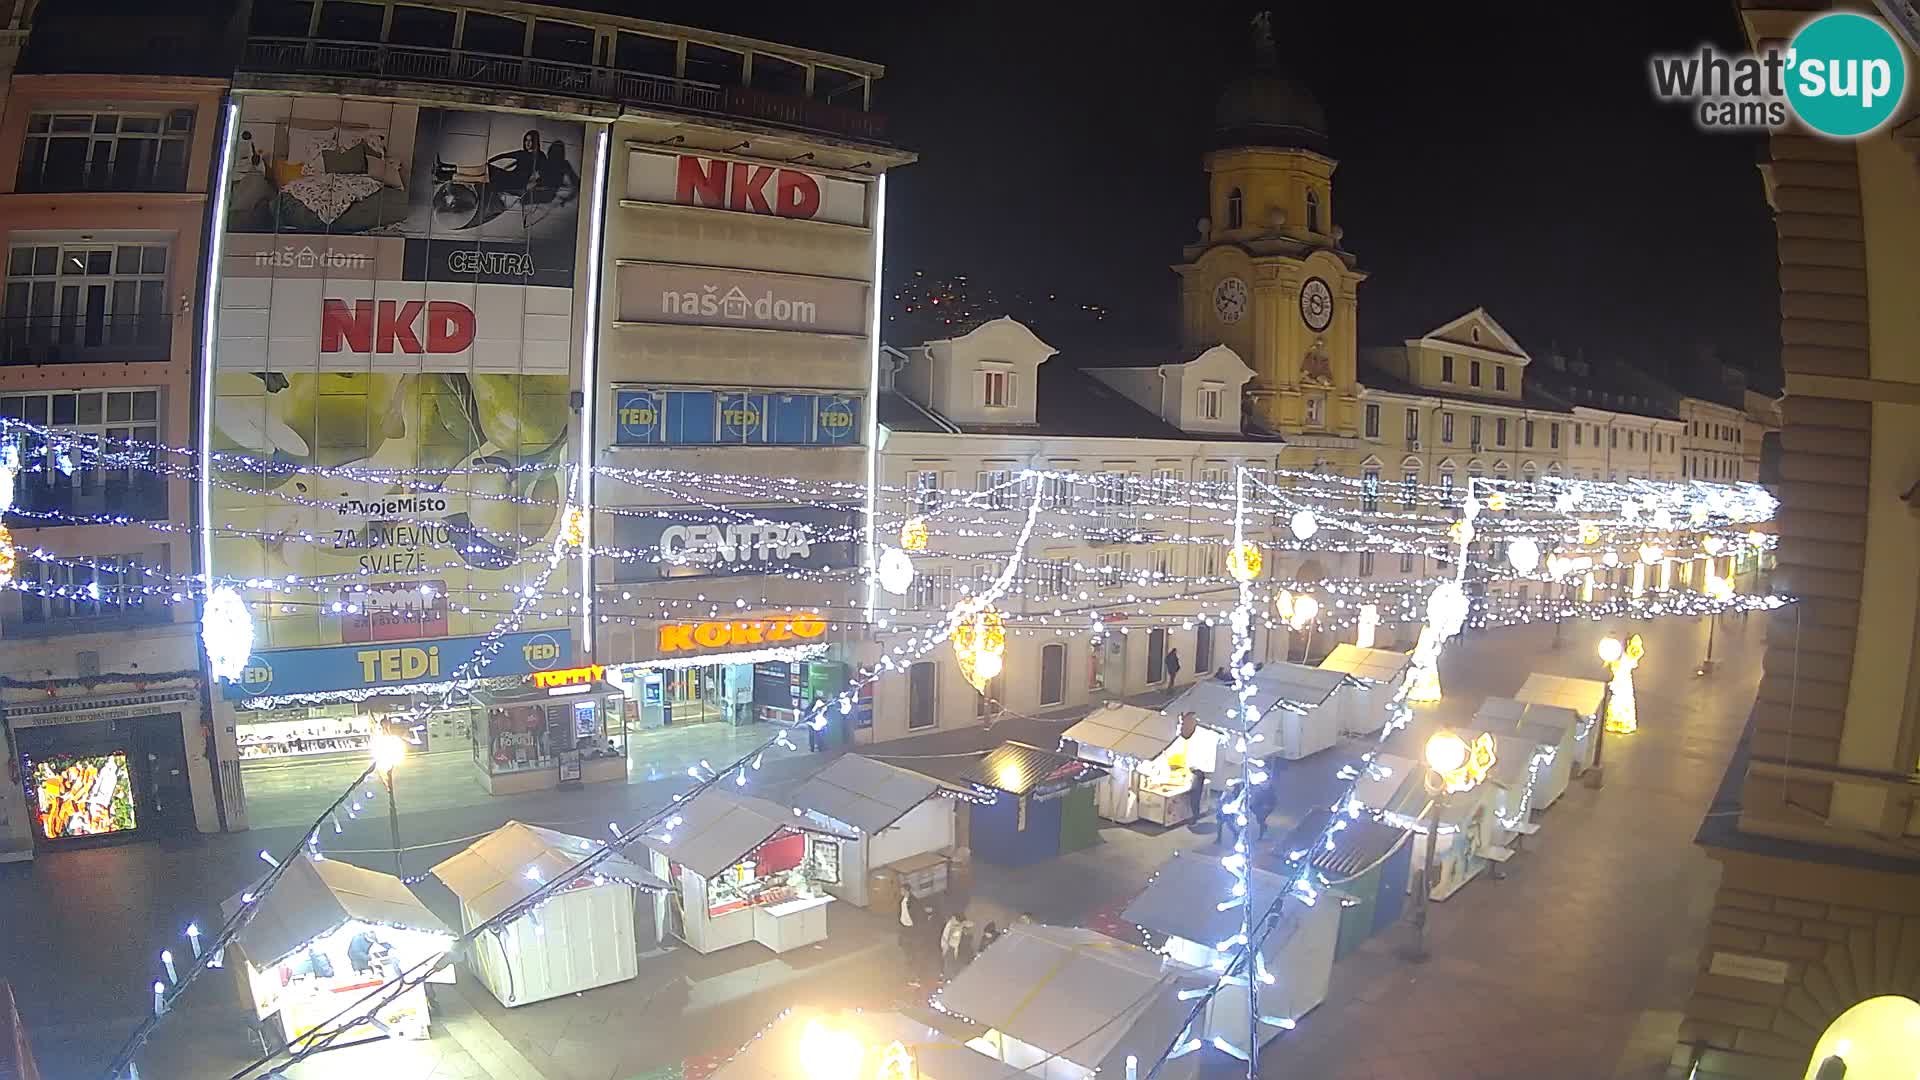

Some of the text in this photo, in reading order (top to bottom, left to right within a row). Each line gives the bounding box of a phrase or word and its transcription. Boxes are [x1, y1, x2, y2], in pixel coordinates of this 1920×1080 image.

[675, 155, 820, 220] NKD
[255, 246, 366, 268] naš dom
[448, 250, 534, 277] CENTRA
[661, 285, 816, 323] naš dom
[320, 298, 476, 354] NKD
[619, 409, 657, 425] TEDi
[723, 410, 760, 426] TEDi
[820, 412, 853, 427] TEDi
[338, 497, 446, 516] #TvojeMisto
[334, 525, 450, 549] ZA DNEVNO
[660, 522, 810, 563] CENTRA
[359, 548, 426, 574] SVJEŽE
[658, 612, 827, 652] KORZO
[357, 646, 439, 682] TEDi
[523, 644, 560, 661] TEDi
[240, 665, 273, 683] EDi
[532, 664, 605, 688] TOMMY
